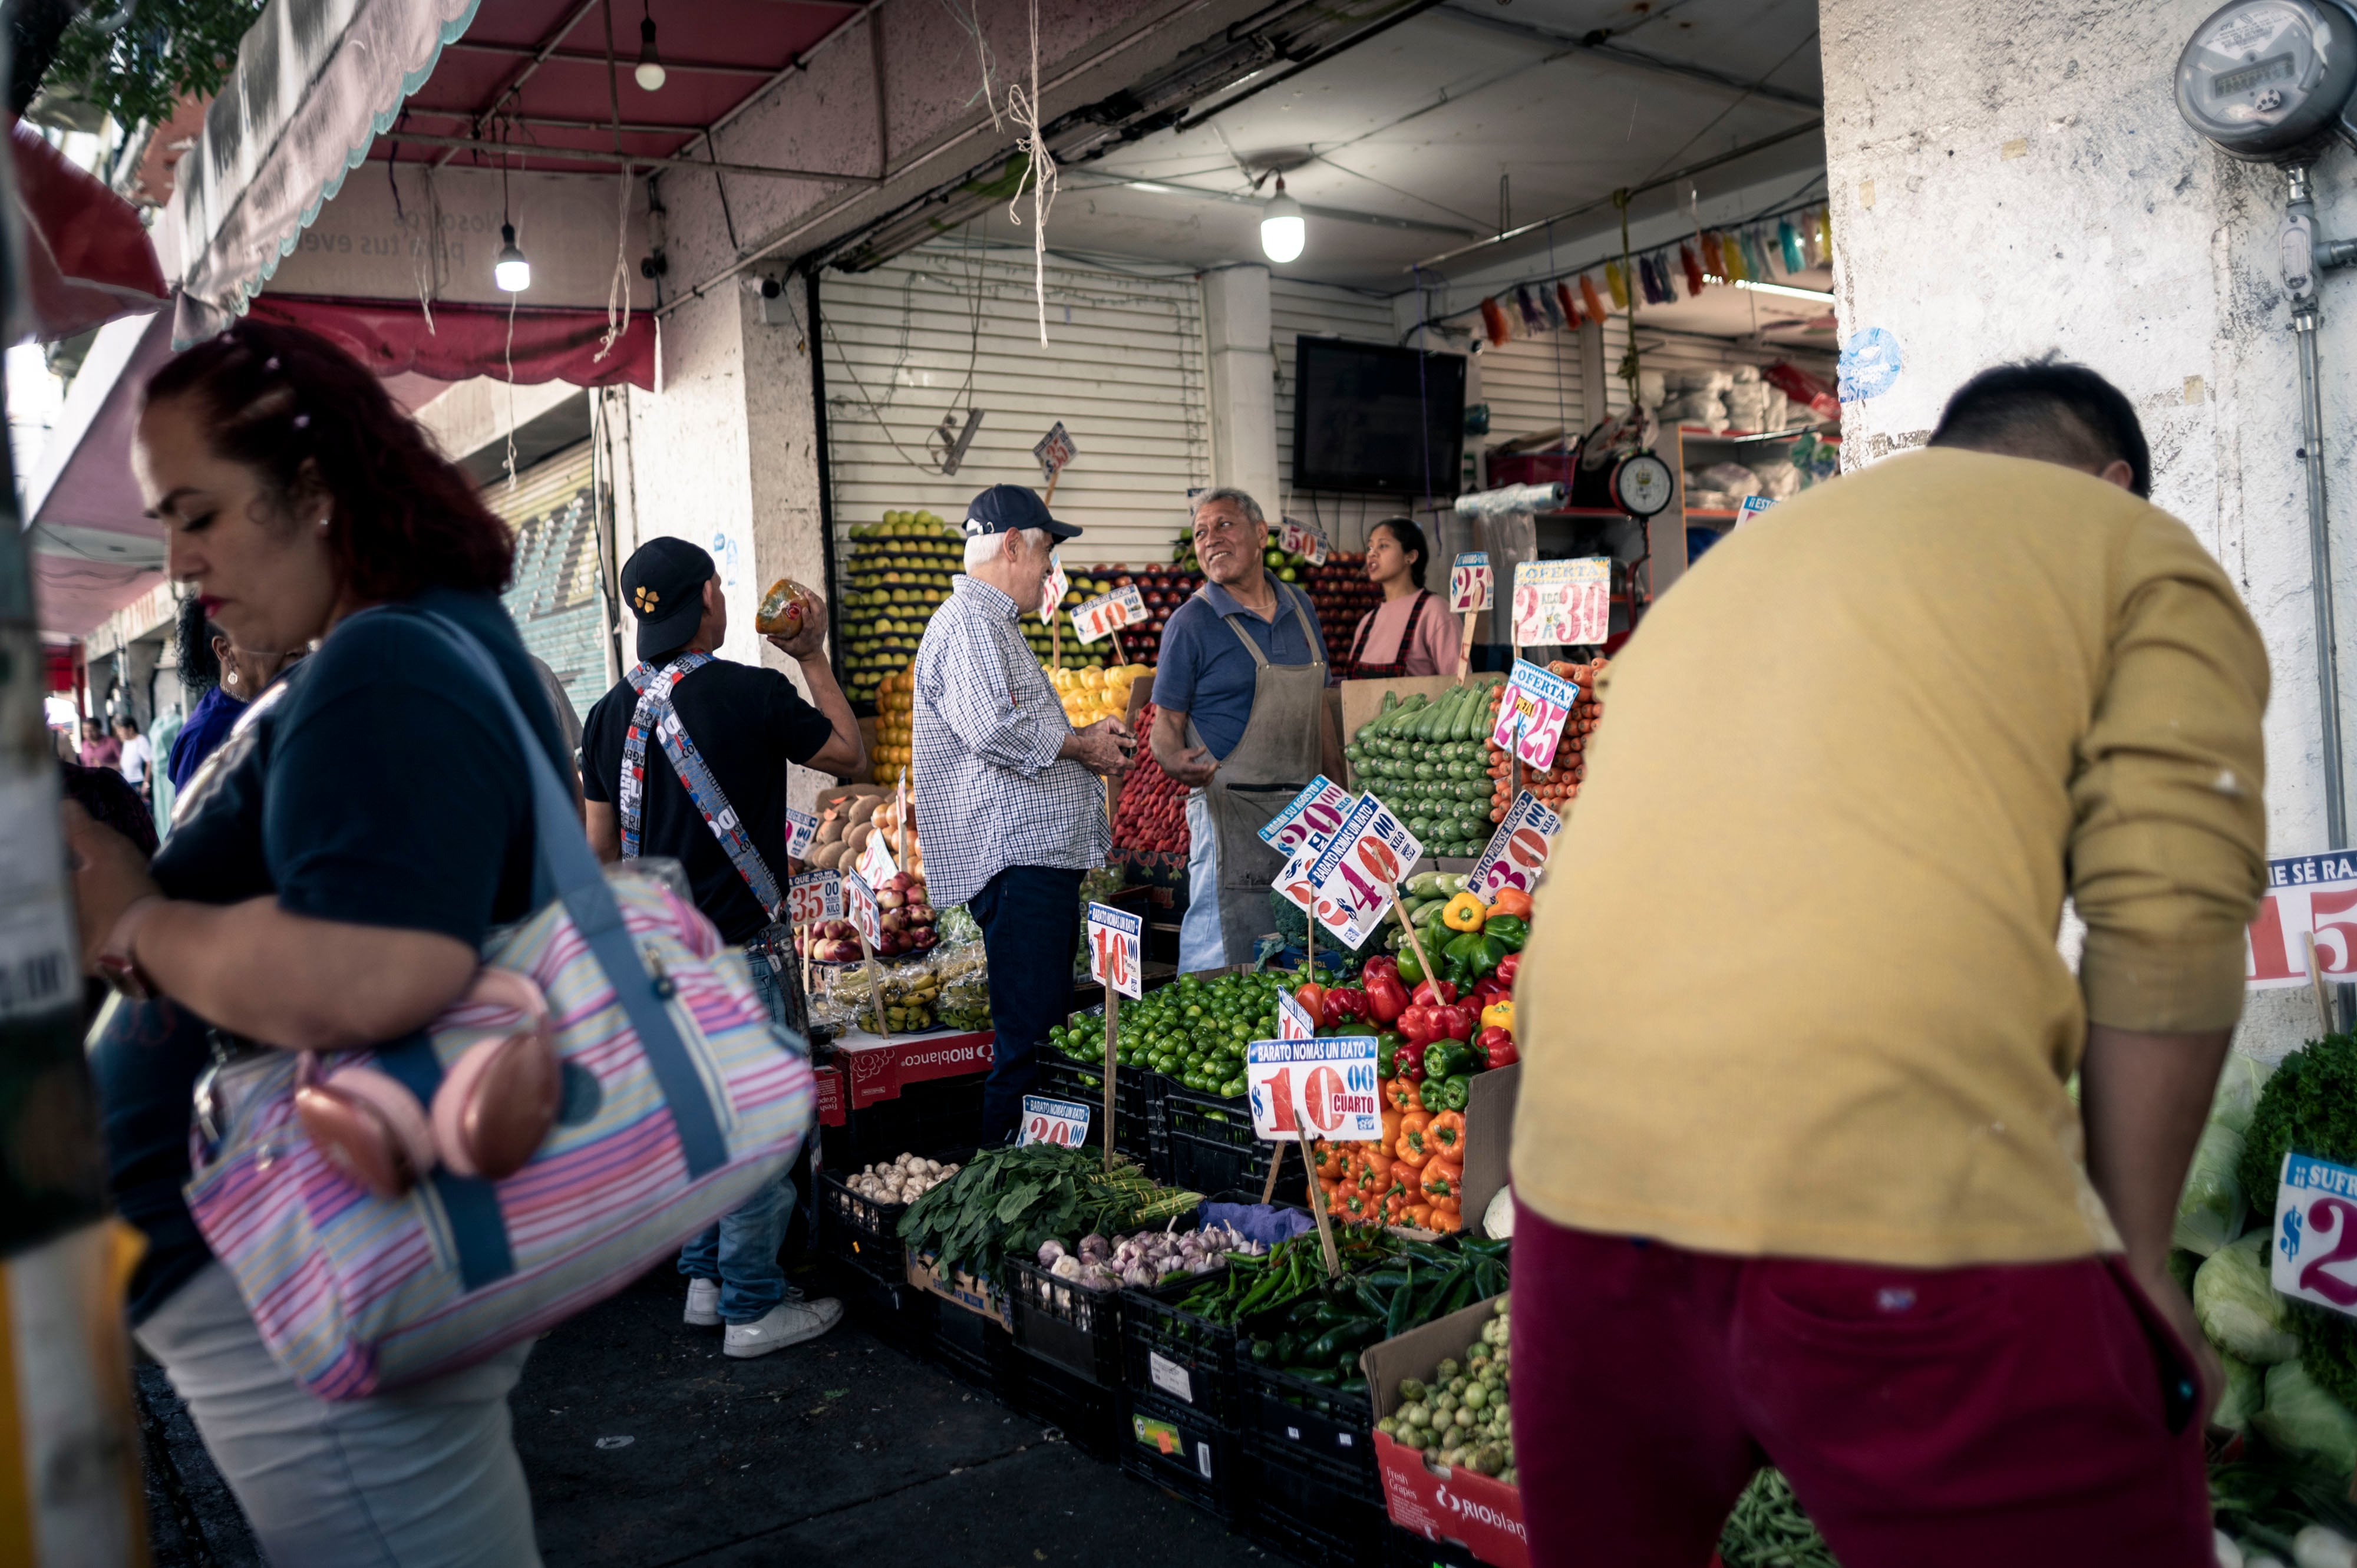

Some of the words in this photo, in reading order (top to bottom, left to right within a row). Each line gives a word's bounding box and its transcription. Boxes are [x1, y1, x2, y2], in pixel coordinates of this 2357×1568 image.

[1517, 669, 1565, 702] OFERTA
[1516, 695, 1534, 718] PIEZA
[1285, 805, 1298, 818] SU
[1335, 797, 1352, 812] KILO
[1525, 803, 1546, 827] 00
[1373, 813, 1395, 840] 00
[1540, 814, 1556, 836] KILO
[1313, 851, 1339, 882] BARATO
[1332, 830, 1356, 856] NOMÁS
[1346, 818, 1360, 836] UN
[1355, 803, 1374, 828] RATO
[1389, 831, 1405, 852] KILO
[1473, 868, 1487, 884] NO
[1483, 856, 1494, 870] LO
[1489, 828, 1509, 859] PIENSE
[1506, 798, 1528, 832] MUCHO
[794, 874, 810, 883] QUE
[2292, 858, 2318, 883] SÉ
[825, 881, 839, 896] 00
[826, 903, 840, 913] KILO
[1092, 907, 1107, 925] BARATO
[1107, 912, 1121, 930] NOMÁS
[1120, 916, 1126, 930] UN
[1125, 918, 1135, 934] RATO
[1128, 938, 1138, 962] 00
[905, 1046, 974, 1067] RIOblanco
[1258, 1045, 1292, 1062] BARATO
[1293, 1040, 1325, 1061] NOMÁS
[1326, 1042, 1339, 1059] UN
[1341, 1041, 1366, 1058] RATO
[1347, 1064, 1374, 1092] 00
[820, 1102, 838, 1113] Fresh
[1030, 1100, 1049, 1114] BARATO
[1049, 1102, 1067, 1117] NOMÁS
[1065, 1107, 1072, 1118] UN
[1072, 1108, 1085, 1120] RATO
[1333, 1094, 1374, 1114] CUARTO
[1069, 1124, 1084, 1145] 00
[1387, 1466, 1408, 1486] Fresh
[1389, 1478, 1417, 1501] Grapes
